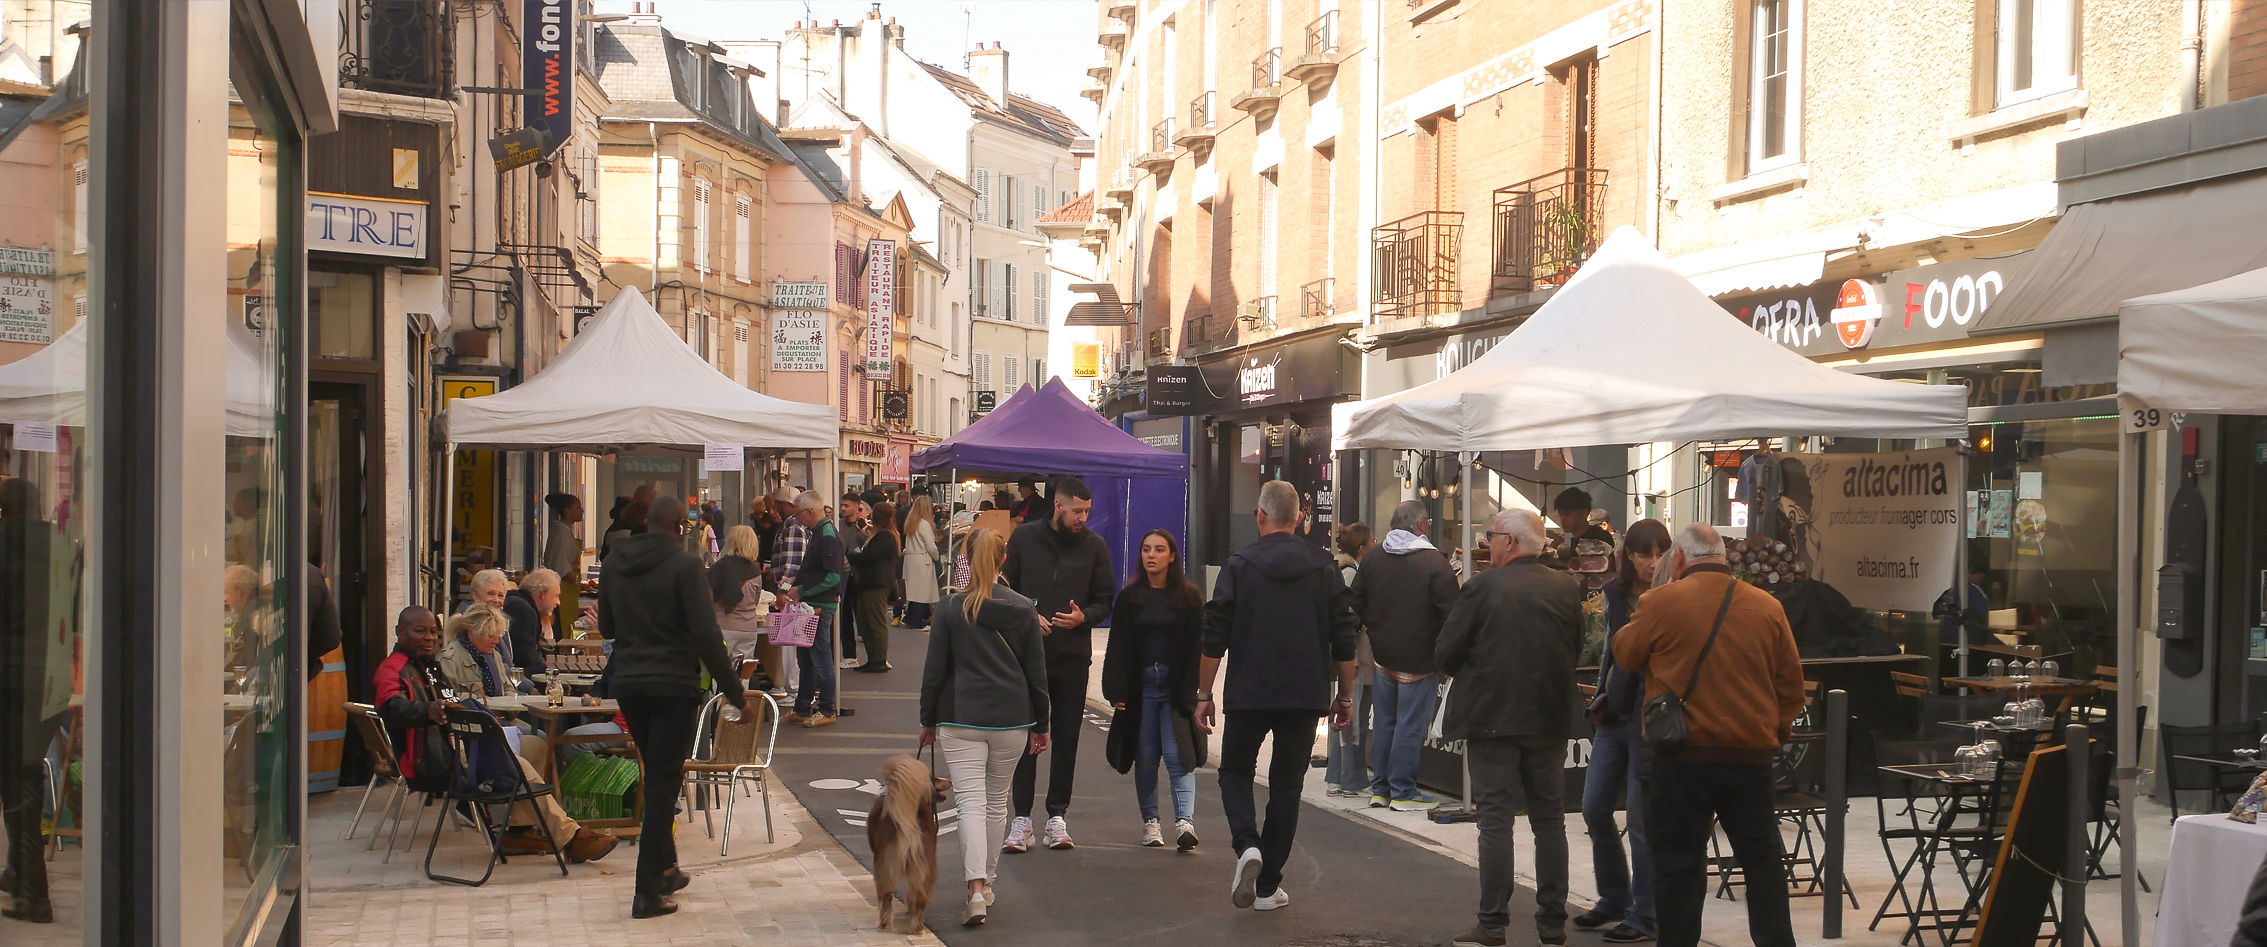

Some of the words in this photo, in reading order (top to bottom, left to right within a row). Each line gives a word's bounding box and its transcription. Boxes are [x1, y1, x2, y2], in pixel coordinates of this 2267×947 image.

[871, 243, 880, 294] TRAITEUR
[882, 244, 892, 311] RESTAURANT
[775, 285, 825, 295] TRAITEUR
[1904, 270, 2004, 330] FOOD
[779, 320, 820, 328] D'ASIE
[787, 311, 812, 319] FLO
[1738, 296, 1821, 348] OFRA
[869, 301, 879, 358] ASIATIQUE
[881, 316, 890, 358] RAPIDE
[1074, 368, 1097, 376] Kodak
[2133, 408, 2161, 428] 39
[849, 440, 864, 456] FLO
[864, 441, 885, 458] D'ASIE
[457, 386, 478, 551] CMERIE
[1395, 464, 1405, 476] 40
[1843, 454, 1947, 498] altacima
[1829, 506, 1880, 528] producteur
[1880, 508, 1928, 529] fromager
[1857, 556, 1920, 579] altacima.fr
